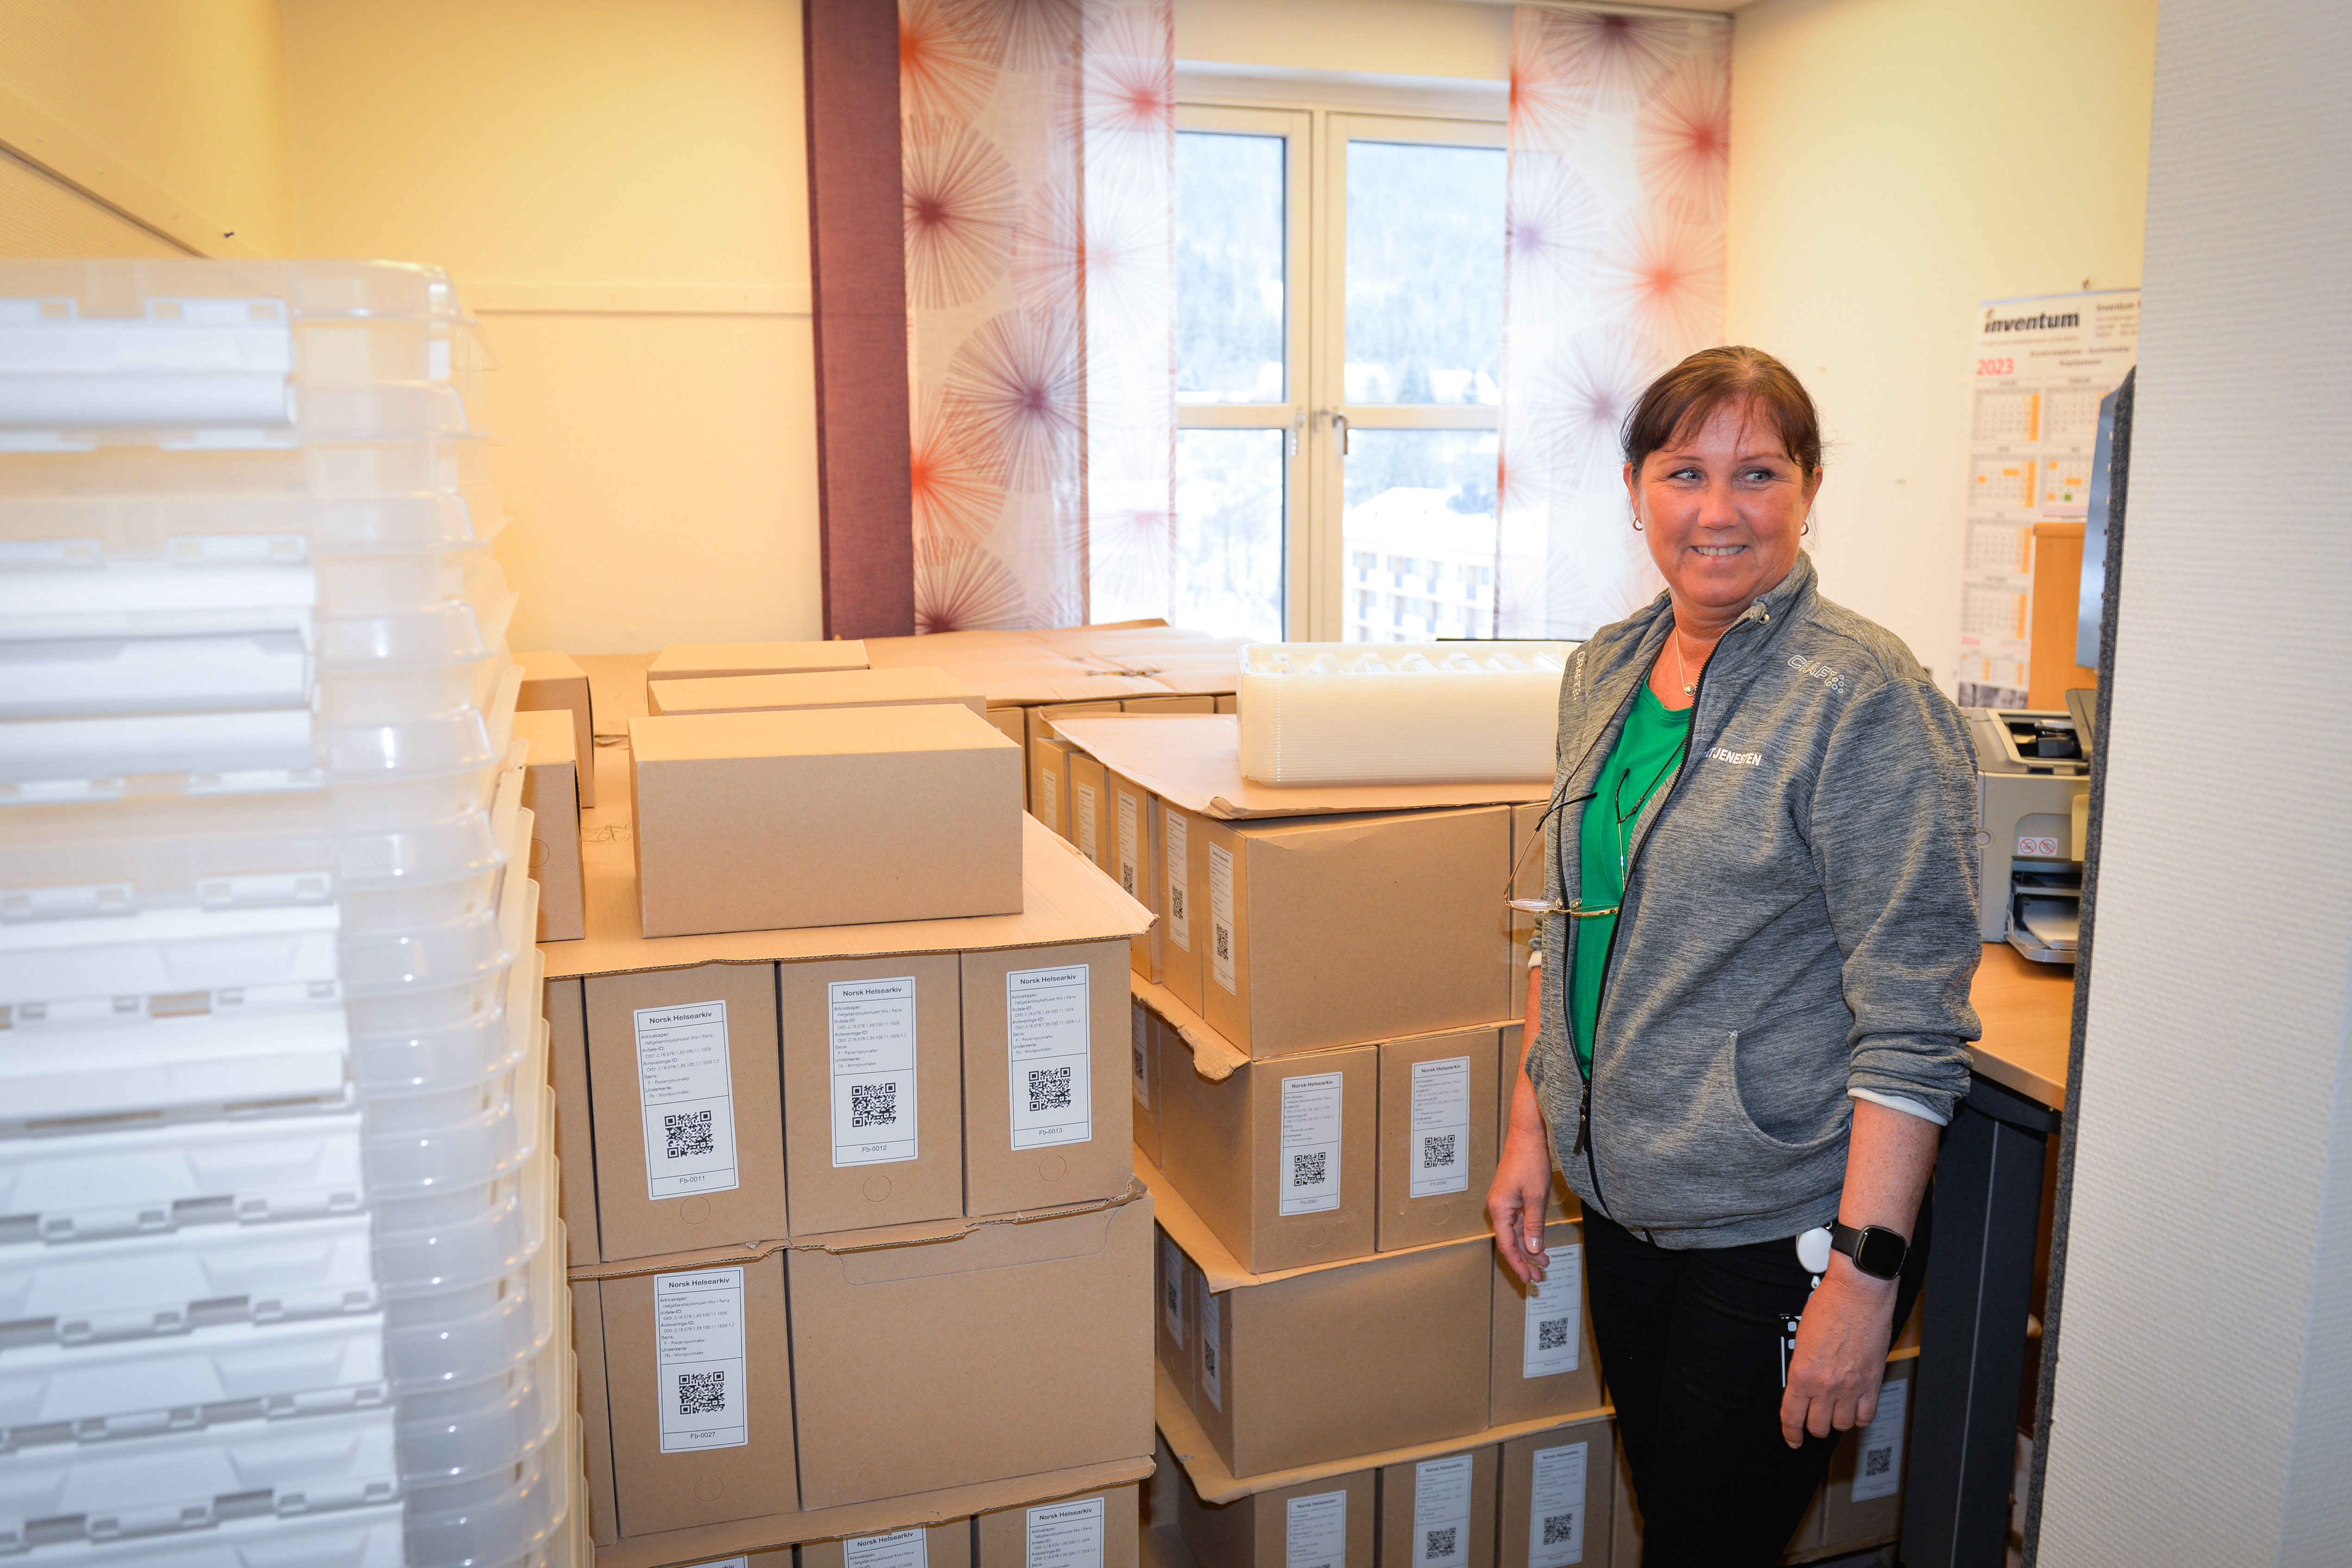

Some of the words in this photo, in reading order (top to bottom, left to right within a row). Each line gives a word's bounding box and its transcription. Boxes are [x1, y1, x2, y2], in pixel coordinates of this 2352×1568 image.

[1985, 308, 2080, 333] inventum
[1977, 357, 2014, 376] 2023
[1042, 974, 1076, 982] Helsearkiv
[673, 1011, 711, 1021] Helsearkiv
[645, 1037, 690, 1045] Helgelandssykehuset
[679, 1175, 705, 1184] Fb-0011
[692, 1277, 729, 1285] Helsearkiv
[1059, 1508, 1092, 1518] Helsearkiv
[879, 1532, 913, 1543] Helsearkiv
